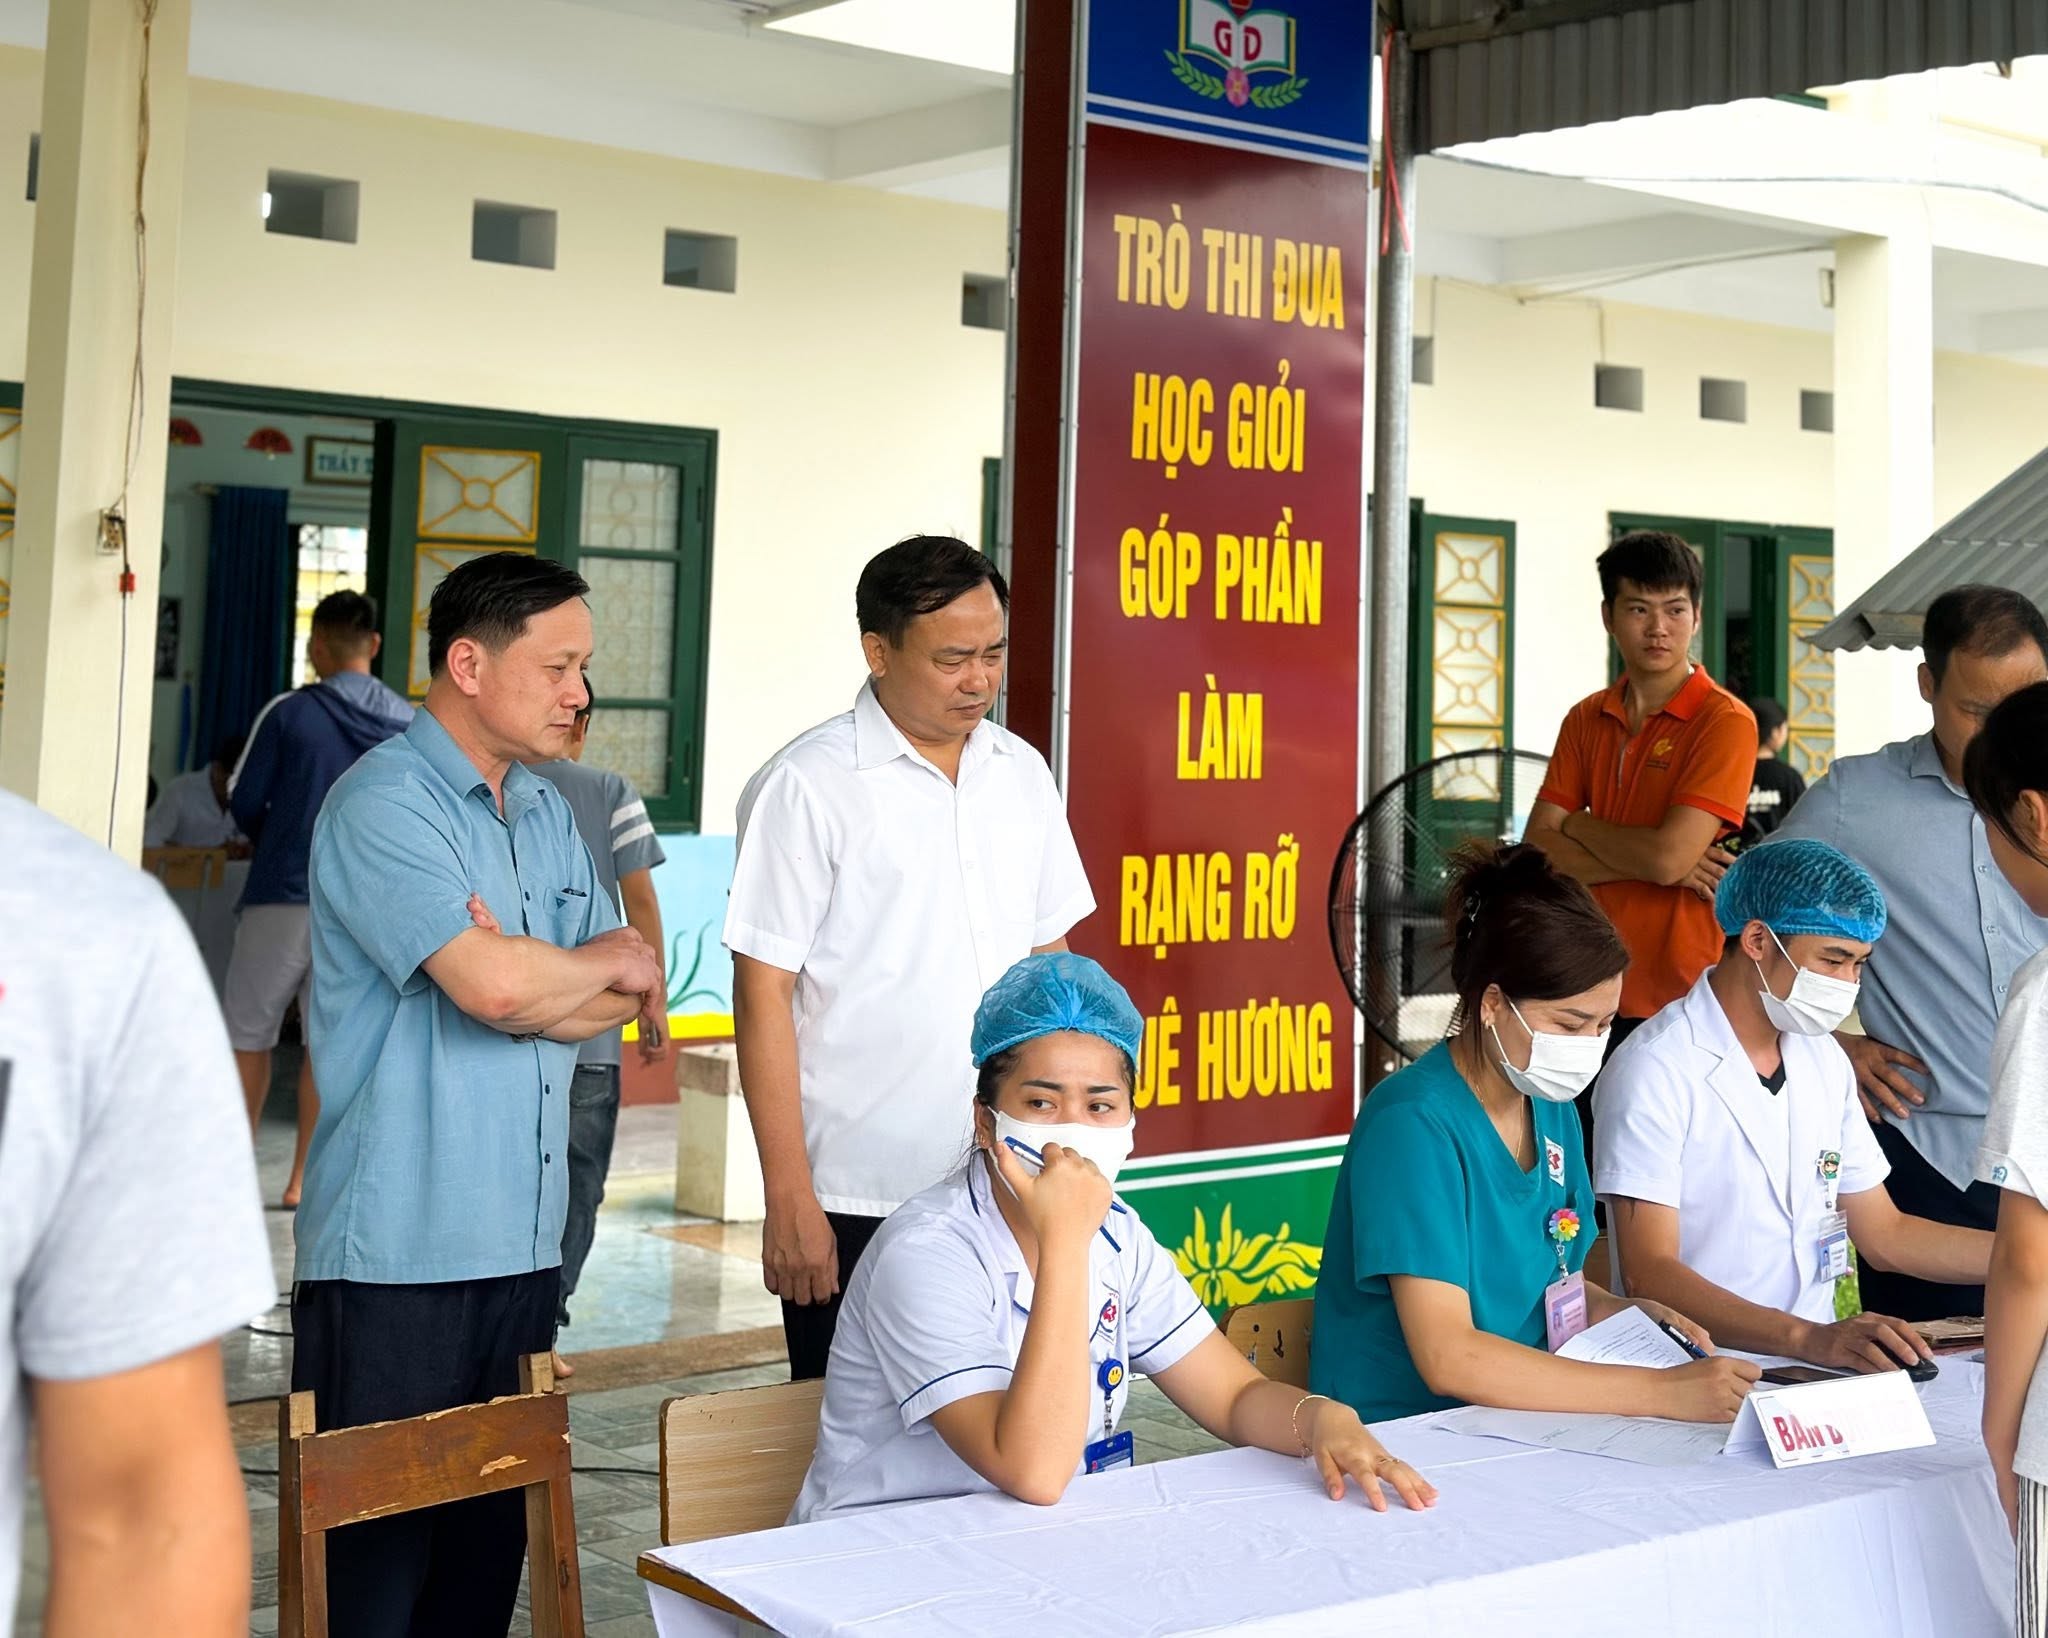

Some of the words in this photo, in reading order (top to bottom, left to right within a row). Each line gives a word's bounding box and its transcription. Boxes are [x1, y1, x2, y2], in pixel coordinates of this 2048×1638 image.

[1113, 204, 1190, 311] TRÒ
[1202, 228, 1263, 319] THI
[1272, 238, 1345, 330] ĐUA
[1131, 371, 1215, 480] HỌC
[1227, 358, 1306, 473] GIỎI
[1119, 512, 1202, 620] GÓP
[1215, 506, 1323, 626] PHẦN
[1176, 673, 1264, 781] LÀM
[1119, 850, 1232, 960] RẠNG
[1243, 832, 1300, 941] RỠ
[1133, 996, 1182, 1109] UÊ
[1197, 997, 1333, 1102] HƯƠNG
